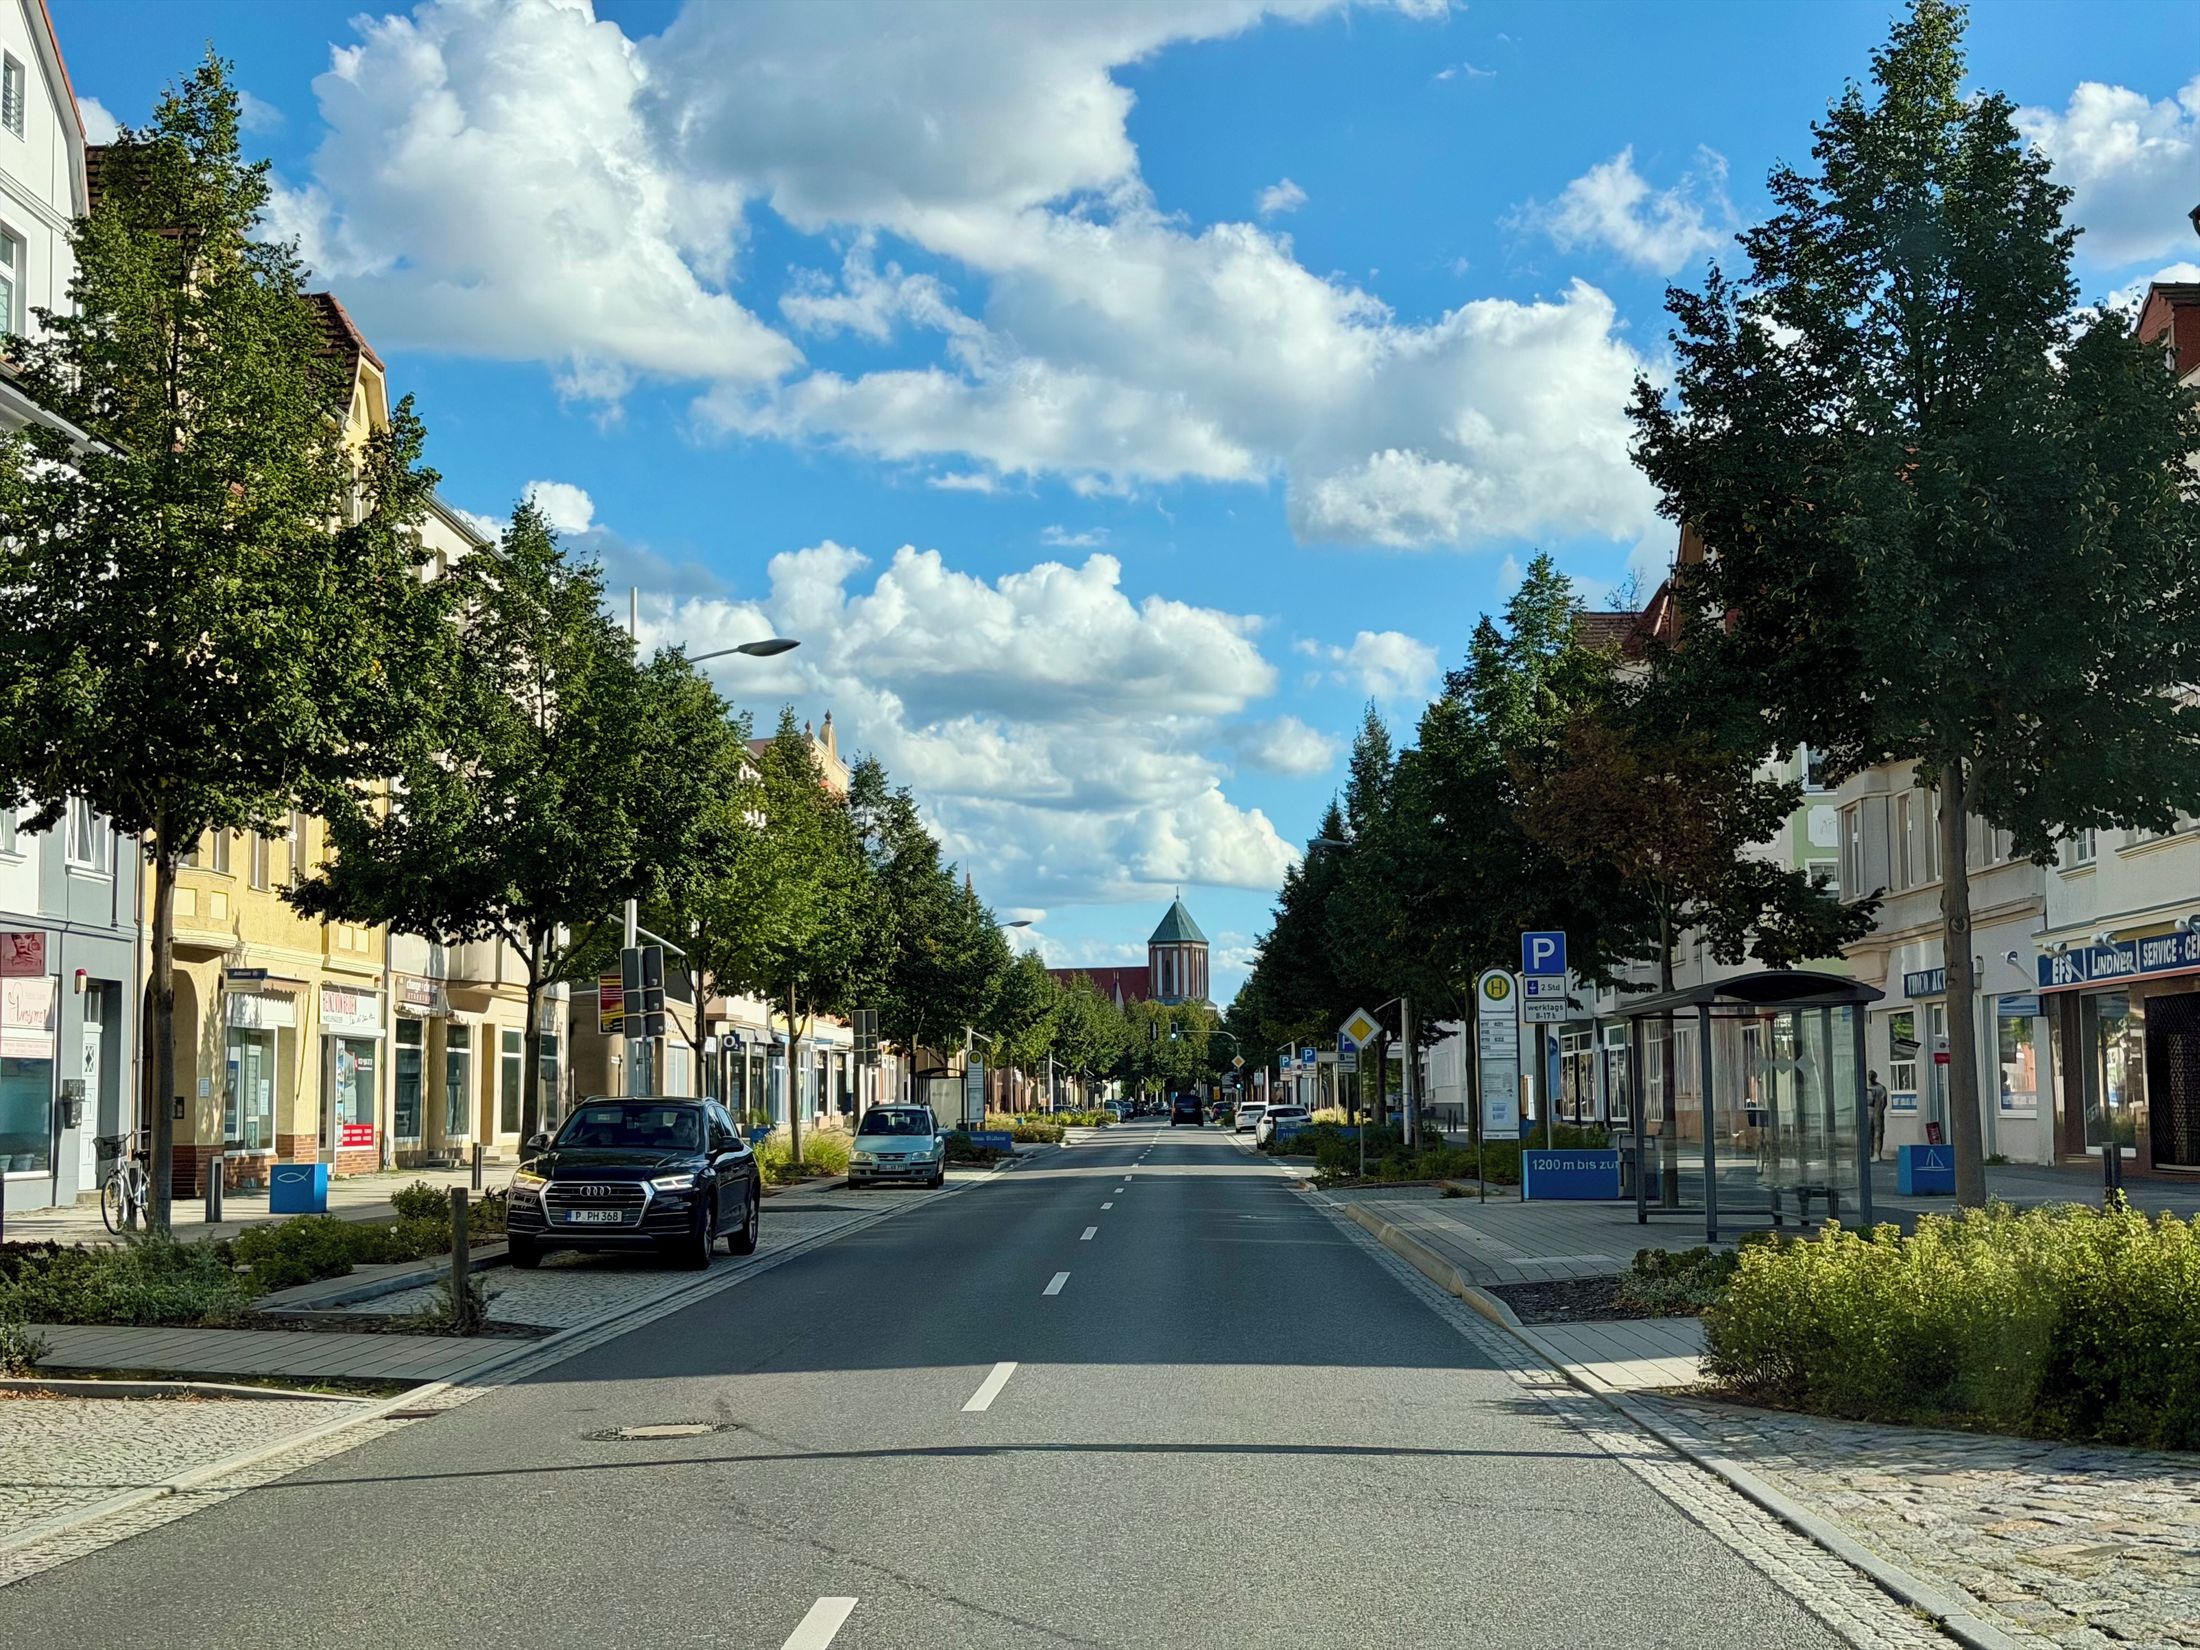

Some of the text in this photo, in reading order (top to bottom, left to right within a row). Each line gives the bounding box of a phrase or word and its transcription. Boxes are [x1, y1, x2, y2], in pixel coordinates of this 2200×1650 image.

[1533, 938, 1555, 969] P
[2143, 938, 2177, 967] SERVICE
[2052, 954, 2073, 985] EFS
[2091, 949, 2133, 977] LINDNER
[1491, 980, 1502, 995] H
[1527, 1003, 1564, 1012] werktags
[1282, 1057, 1289, 1066] P
[1305, 1050, 1312, 1060] P
[1532, 1159, 1560, 1170] 1200
[1563, 1161, 1575, 1170] m
[1577, 1159, 1597, 1170] bis
[575, 1211, 619, 1221] P PH 368
